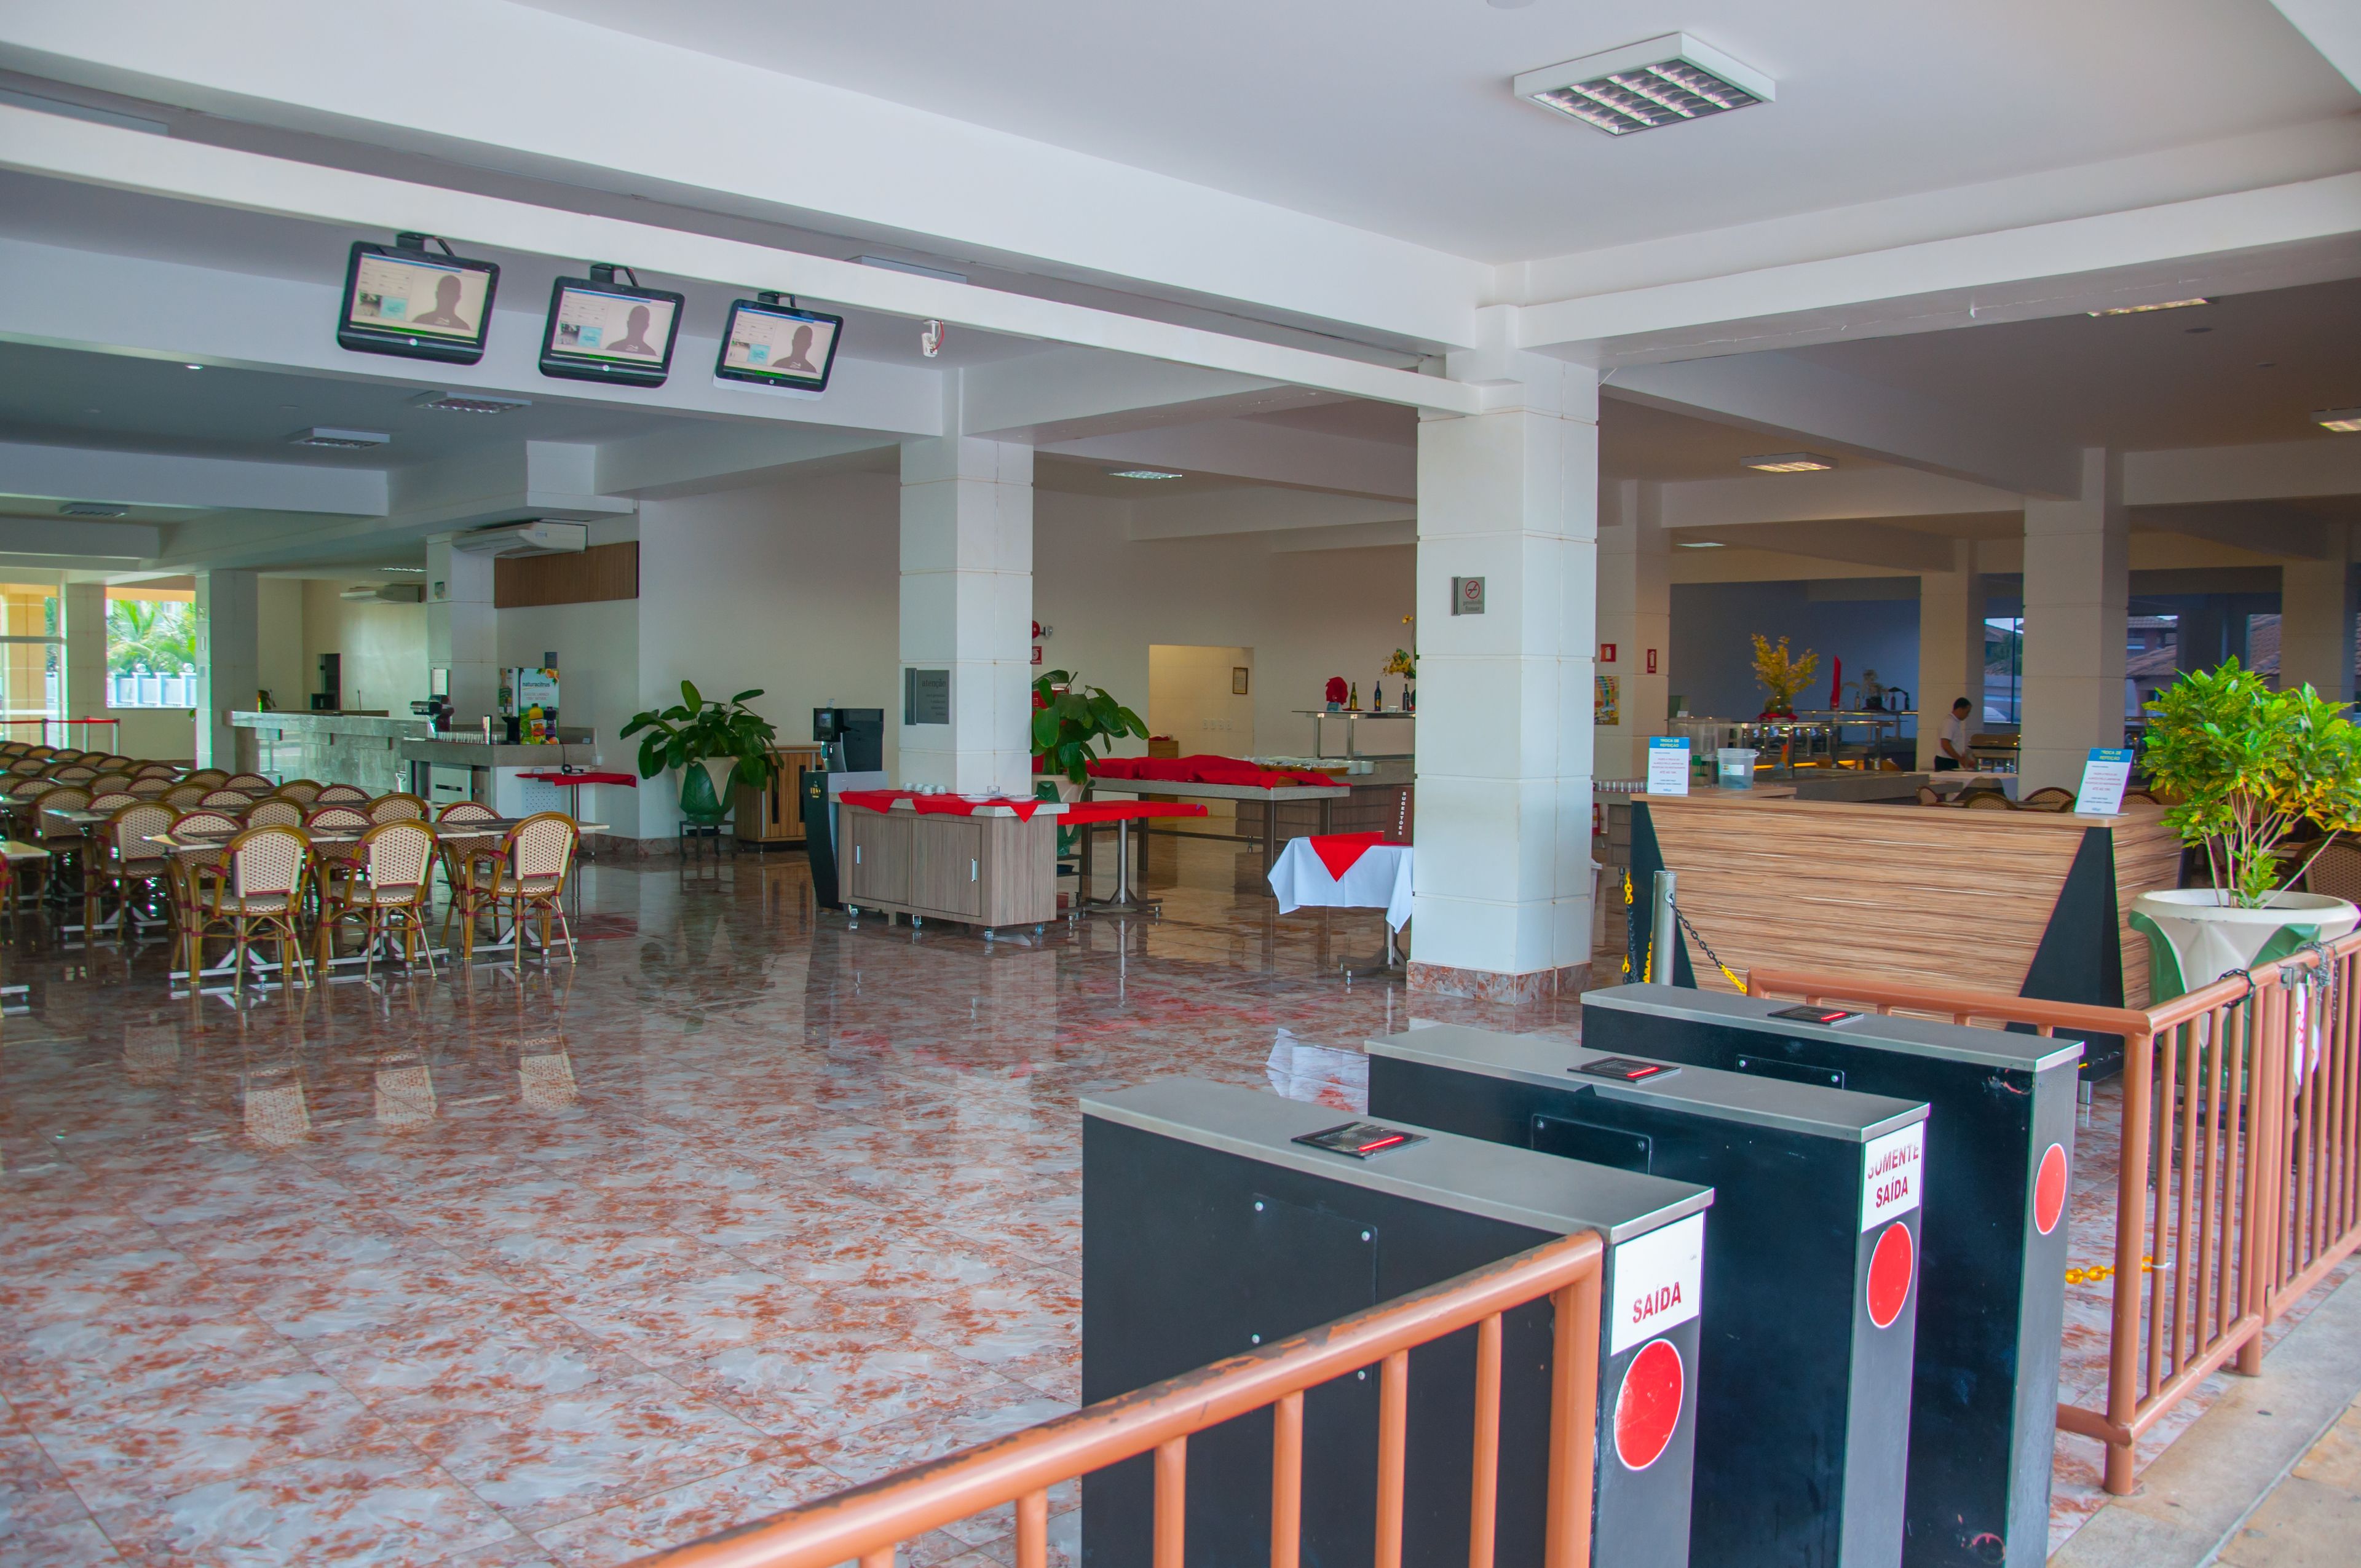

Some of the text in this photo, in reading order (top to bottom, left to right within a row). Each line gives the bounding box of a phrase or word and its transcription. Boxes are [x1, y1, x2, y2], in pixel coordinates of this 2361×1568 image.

[922, 678, 946, 688] atenção
[1876, 1175, 1908, 1209] SAÍDA
[1632, 1281, 1682, 1324] SAÍDA
